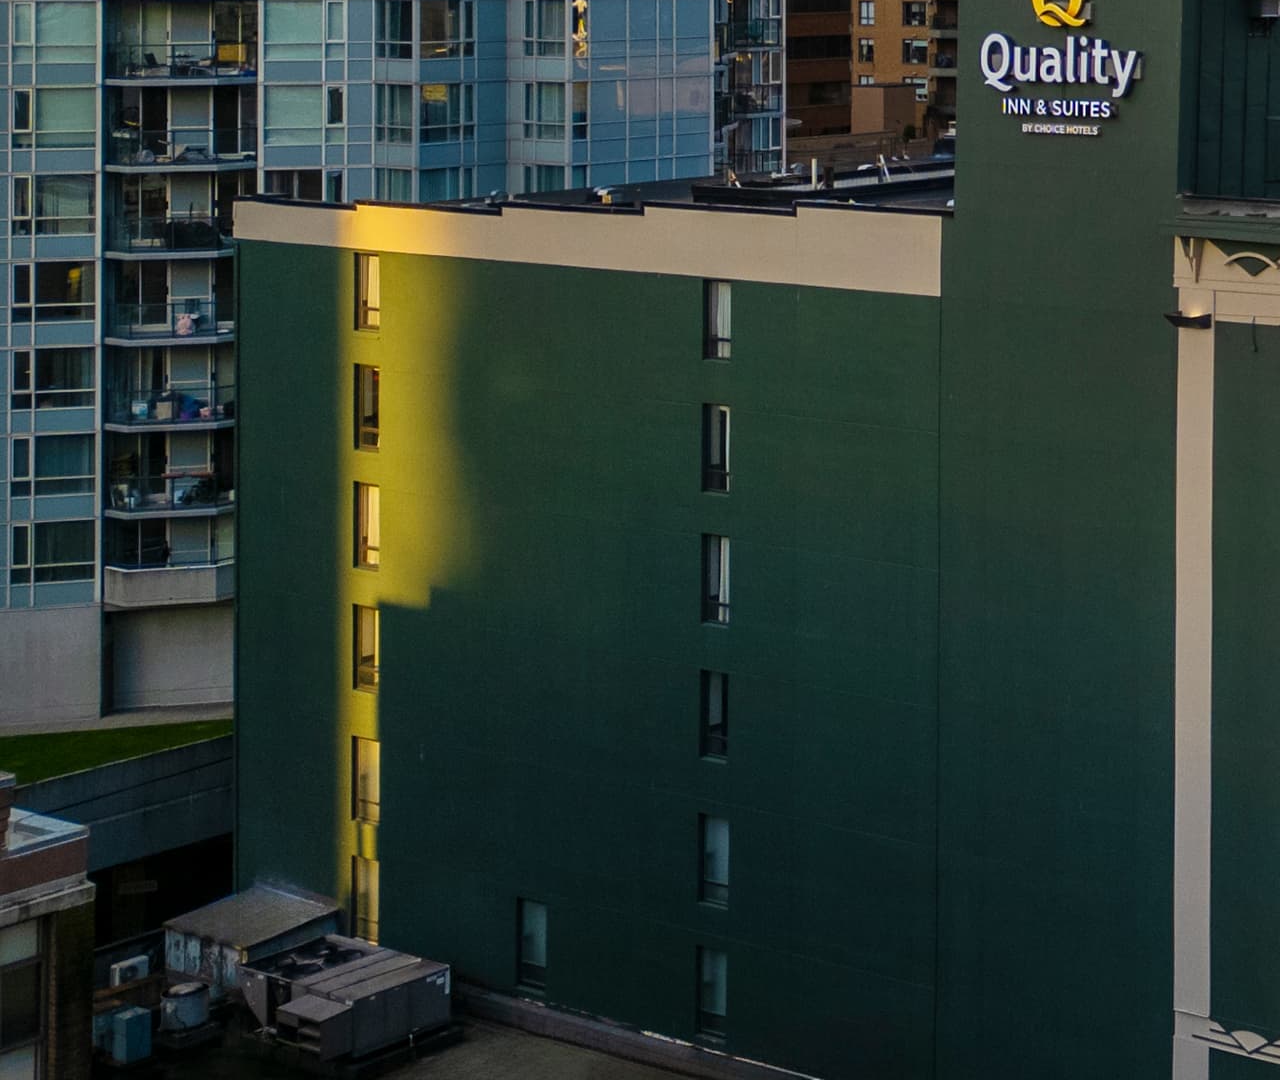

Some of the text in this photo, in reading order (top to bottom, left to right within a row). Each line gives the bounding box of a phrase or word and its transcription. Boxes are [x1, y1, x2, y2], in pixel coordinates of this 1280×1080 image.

[980, 33, 1137, 98] Quality
[1002, 98, 1111, 118] INN & SUITES
[1022, 123, 1098, 136] BY CHOICE HOTELS
